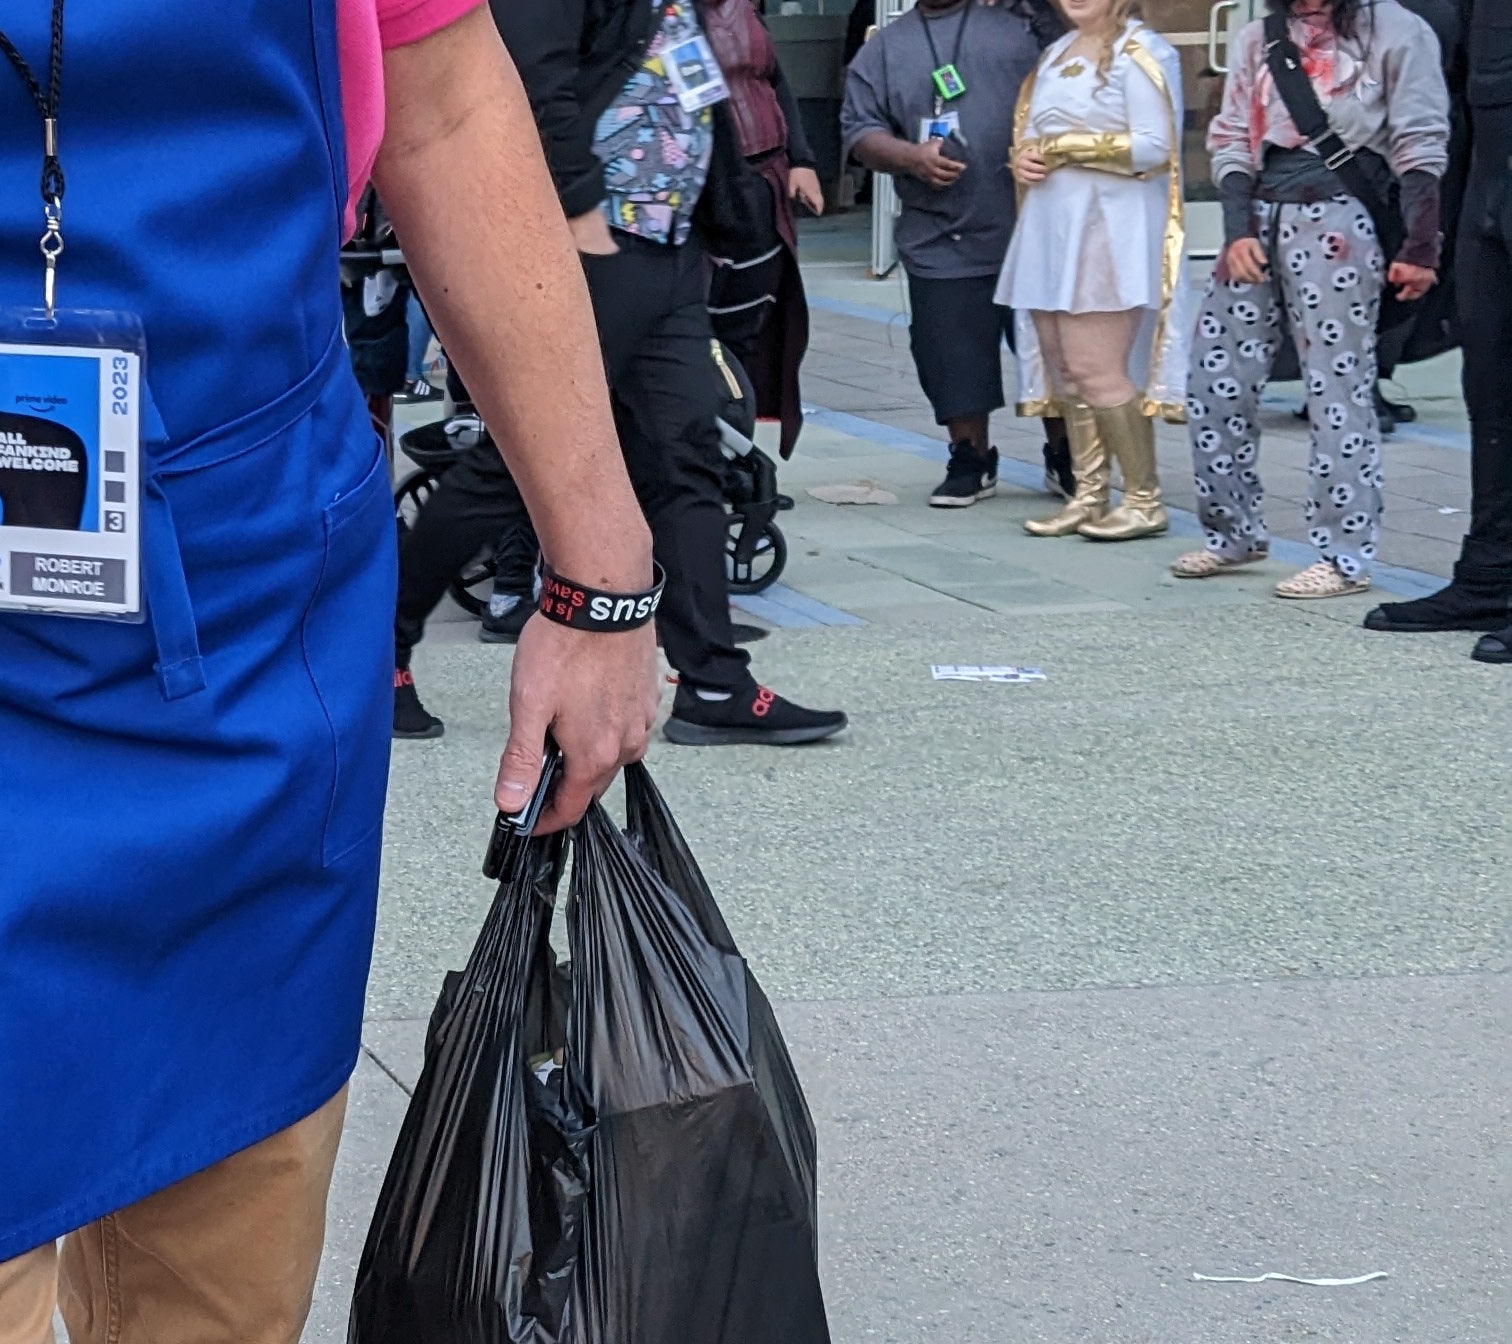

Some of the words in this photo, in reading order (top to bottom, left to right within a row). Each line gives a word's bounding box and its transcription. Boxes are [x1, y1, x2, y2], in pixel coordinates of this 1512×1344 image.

[112, 357, 129, 416] 2023
[109, 512, 123, 531] 3
[34, 557, 104, 576] ROBERT
[32, 577, 105, 596] MONROE
[589, 588, 664, 623] esus
